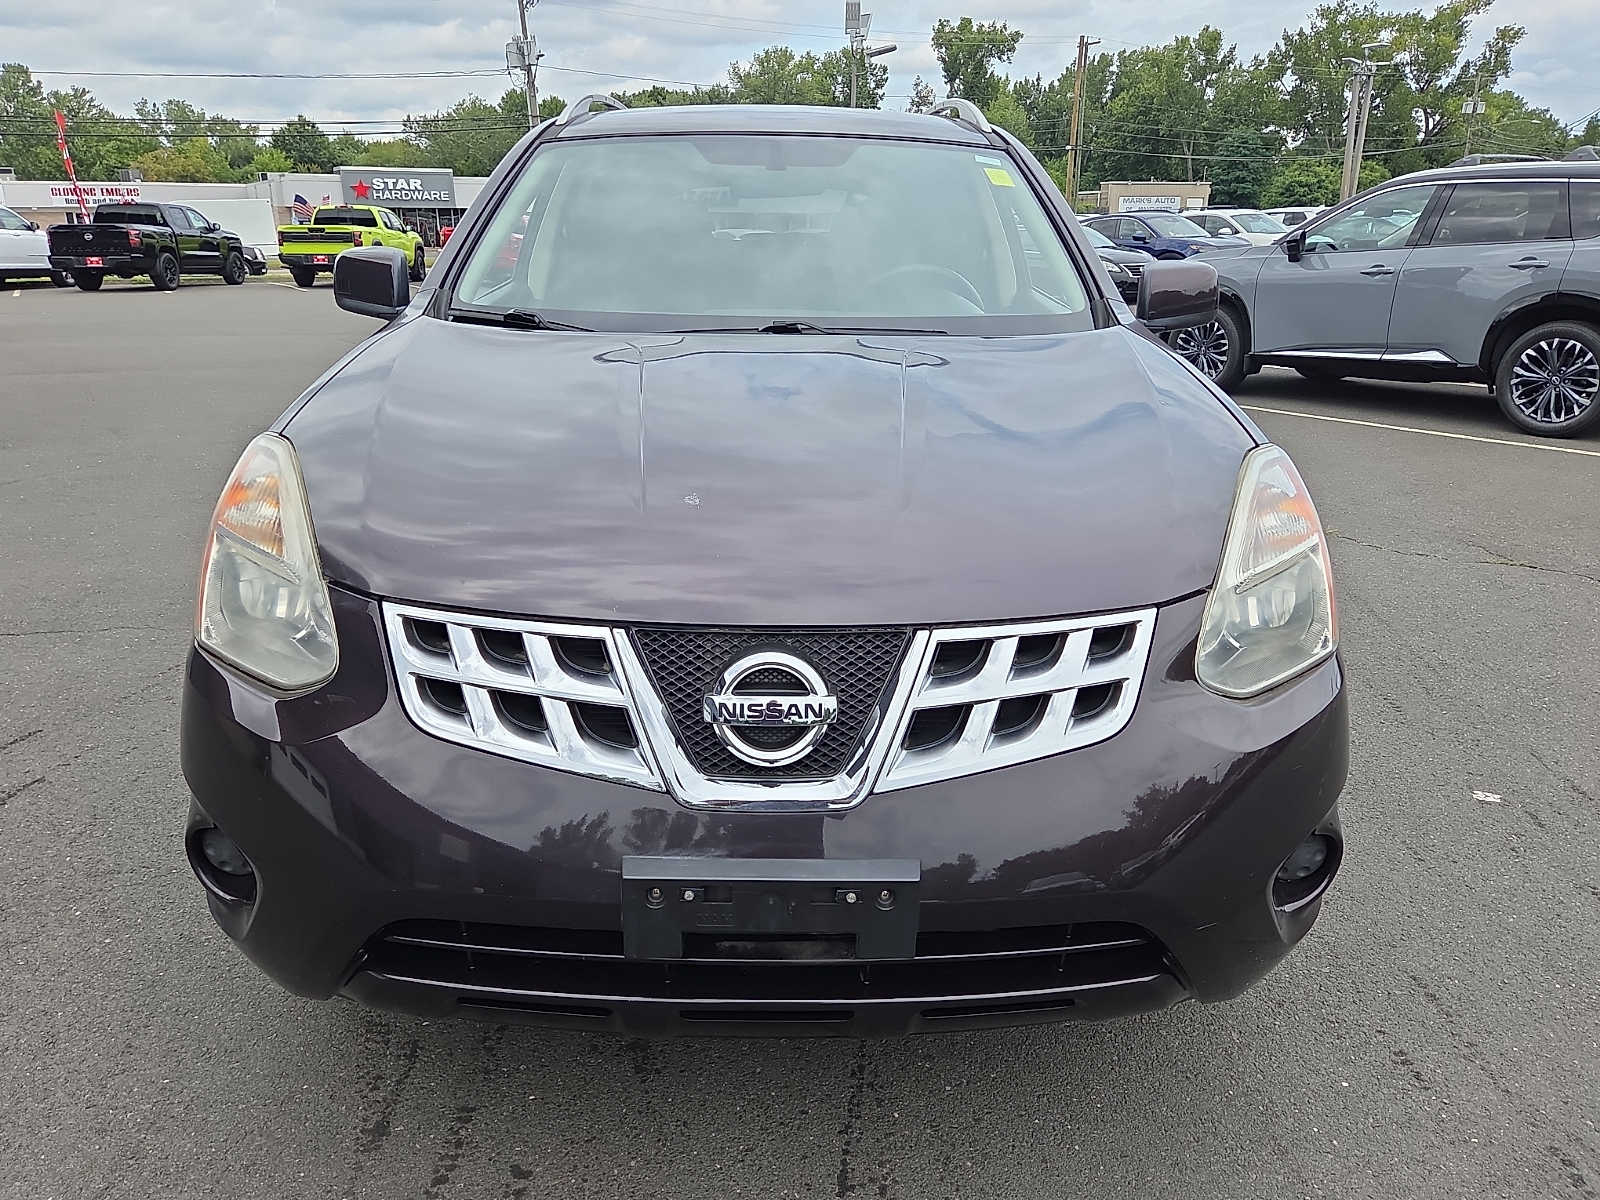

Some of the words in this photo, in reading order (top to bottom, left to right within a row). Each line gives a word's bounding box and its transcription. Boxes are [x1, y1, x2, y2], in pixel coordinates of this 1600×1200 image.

[372, 178, 423, 190] STAR
[372, 190, 449, 200] HARDWARE
[718, 702, 823, 720] NISSAN
